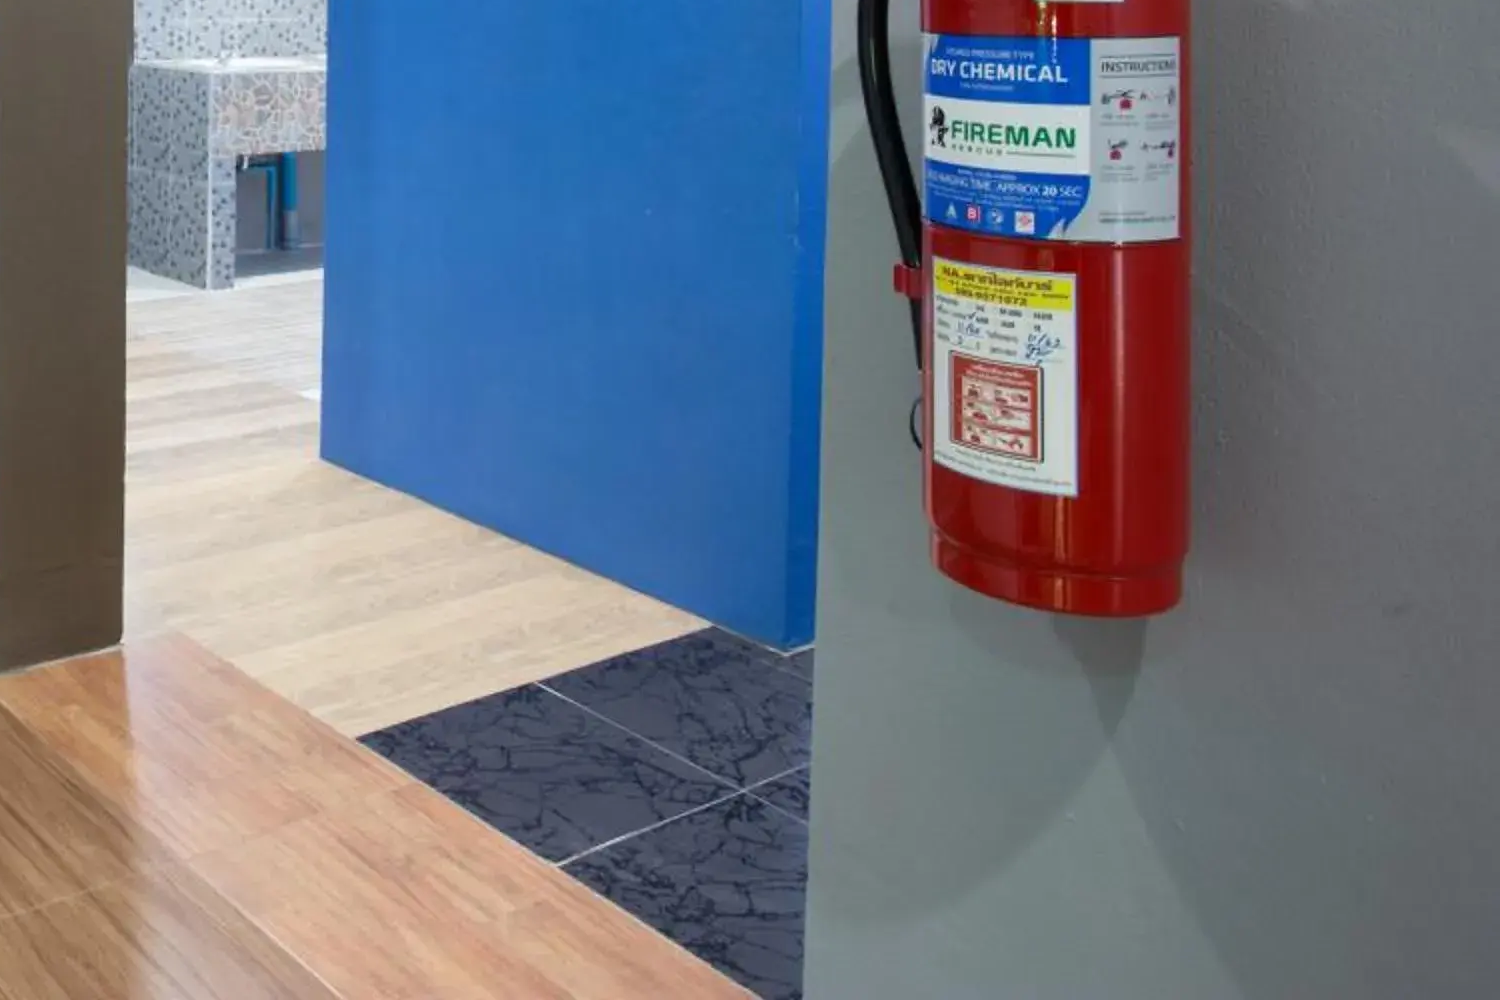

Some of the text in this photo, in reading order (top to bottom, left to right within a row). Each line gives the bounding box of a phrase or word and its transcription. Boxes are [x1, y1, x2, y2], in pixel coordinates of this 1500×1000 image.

[931, 58, 1068, 84] DRY CHEMICAL
[951, 120, 1077, 149] FIREMAN
